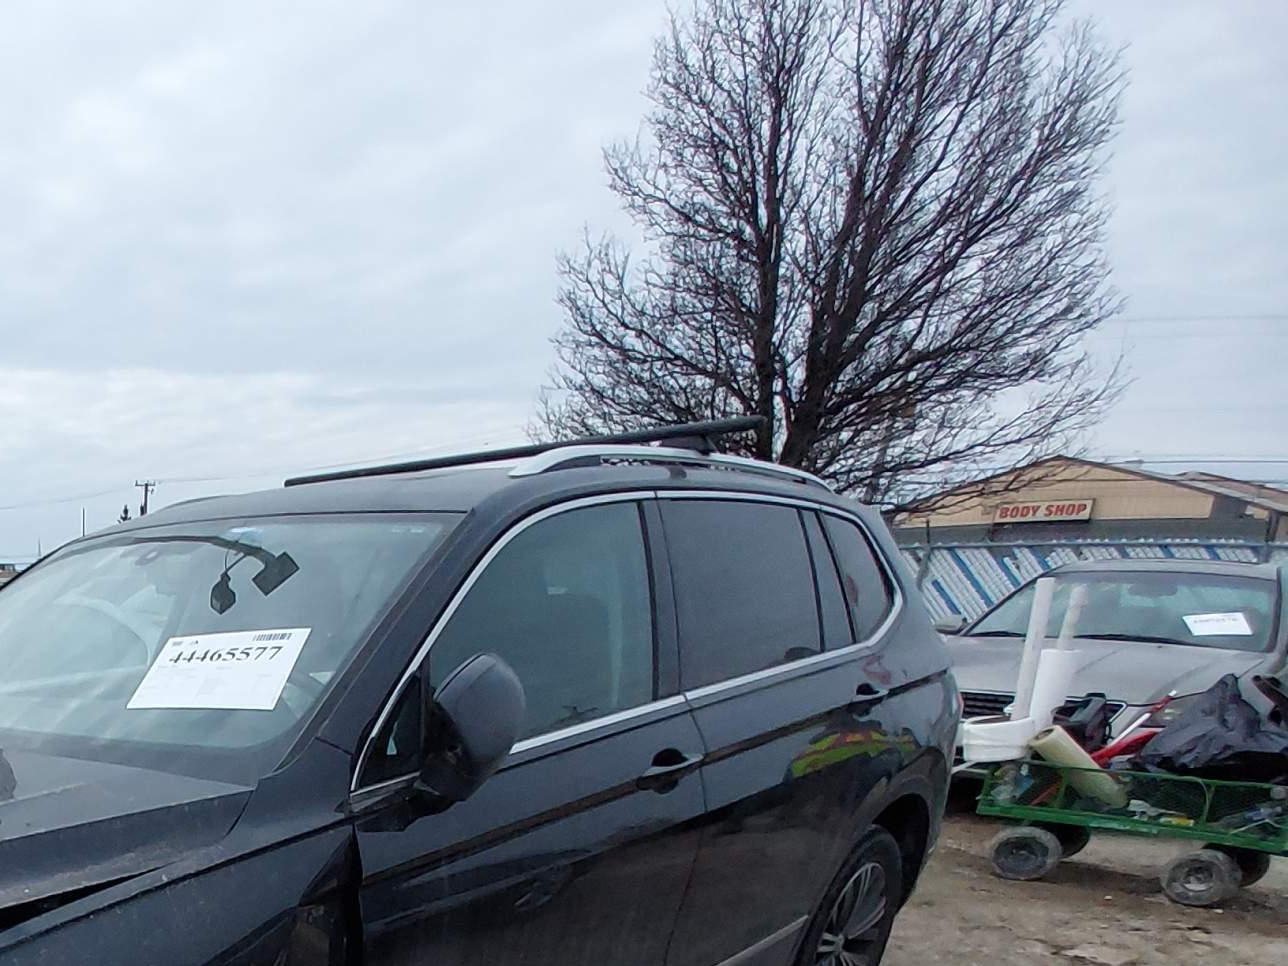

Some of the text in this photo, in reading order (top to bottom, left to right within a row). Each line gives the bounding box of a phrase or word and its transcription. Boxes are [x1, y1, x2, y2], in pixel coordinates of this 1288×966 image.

[999, 503, 1087, 518] BODY SHOP
[169, 646, 284, 664] 44465577
